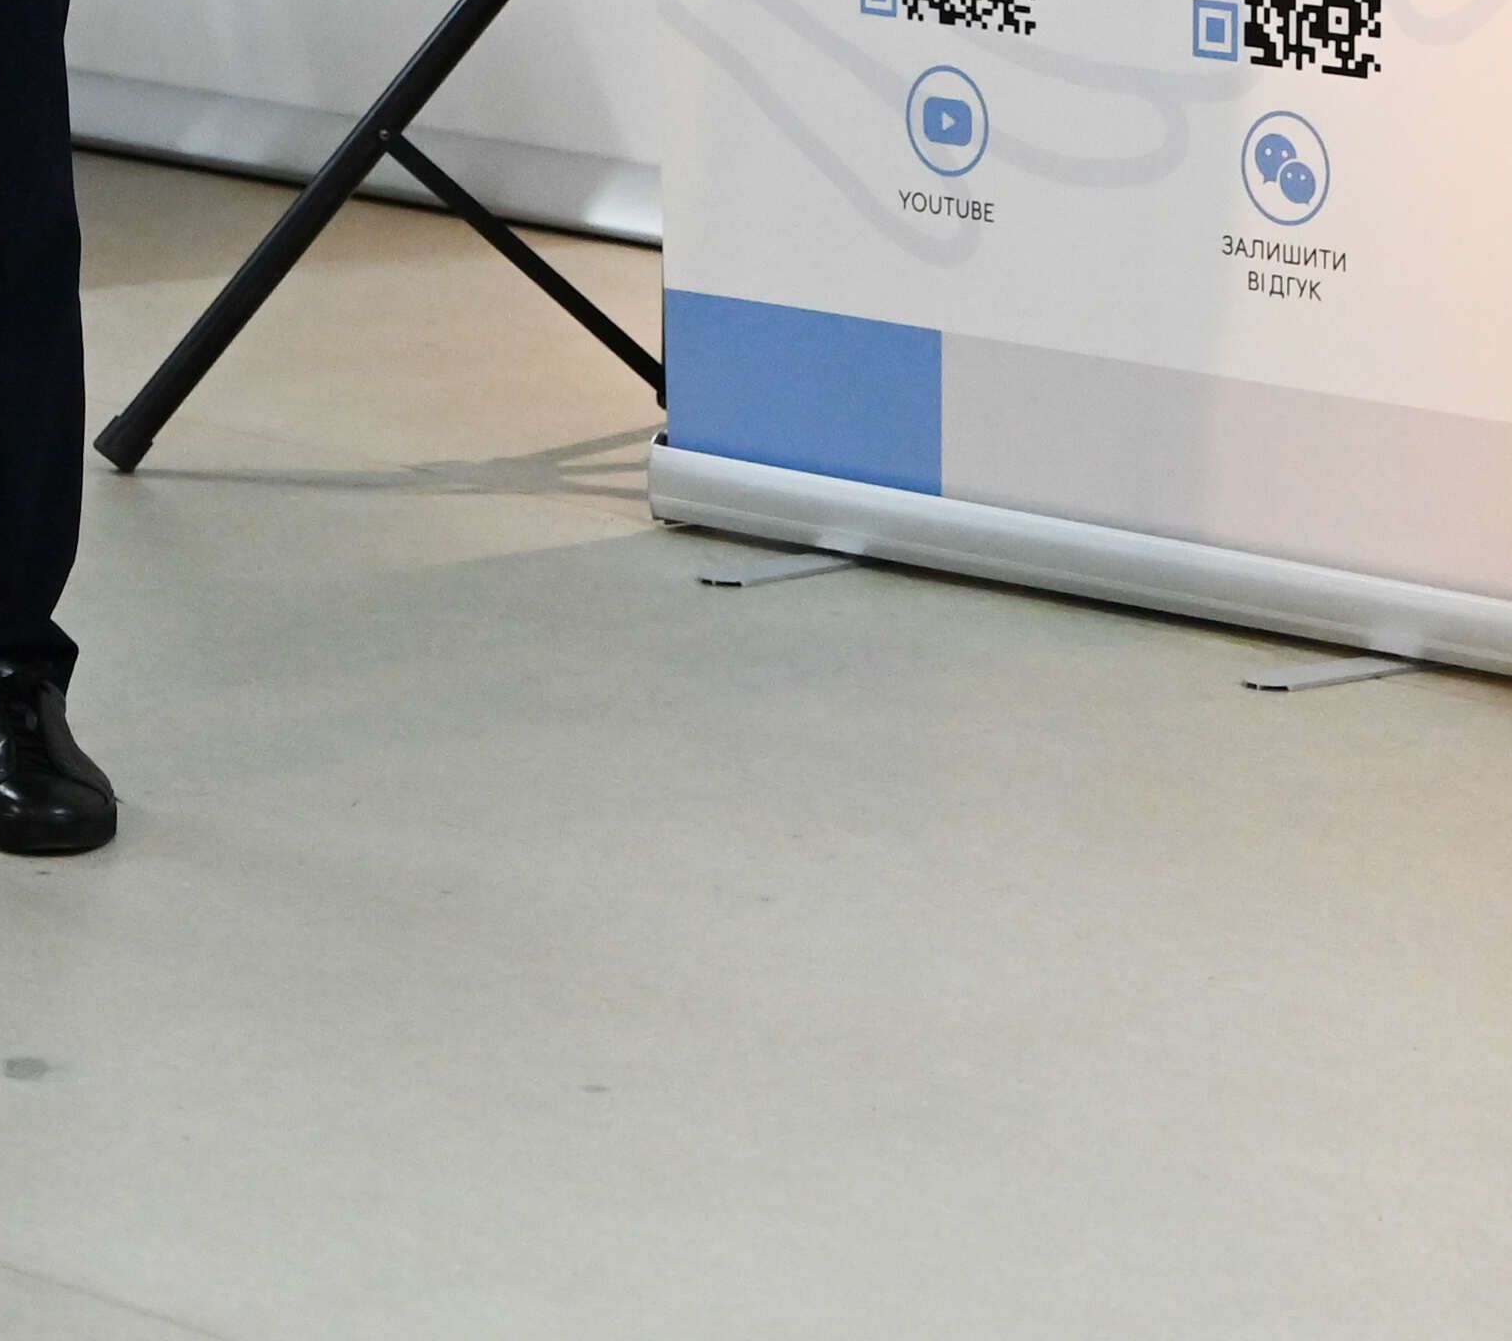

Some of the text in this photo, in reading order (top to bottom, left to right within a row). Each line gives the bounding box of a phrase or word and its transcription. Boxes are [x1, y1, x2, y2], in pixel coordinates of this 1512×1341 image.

[898, 190, 995, 223] YOUTUBE
[1221, 234, 1347, 273] ЗАЛИШИТИ
[1248, 270, 1323, 302] ВІДГУК
